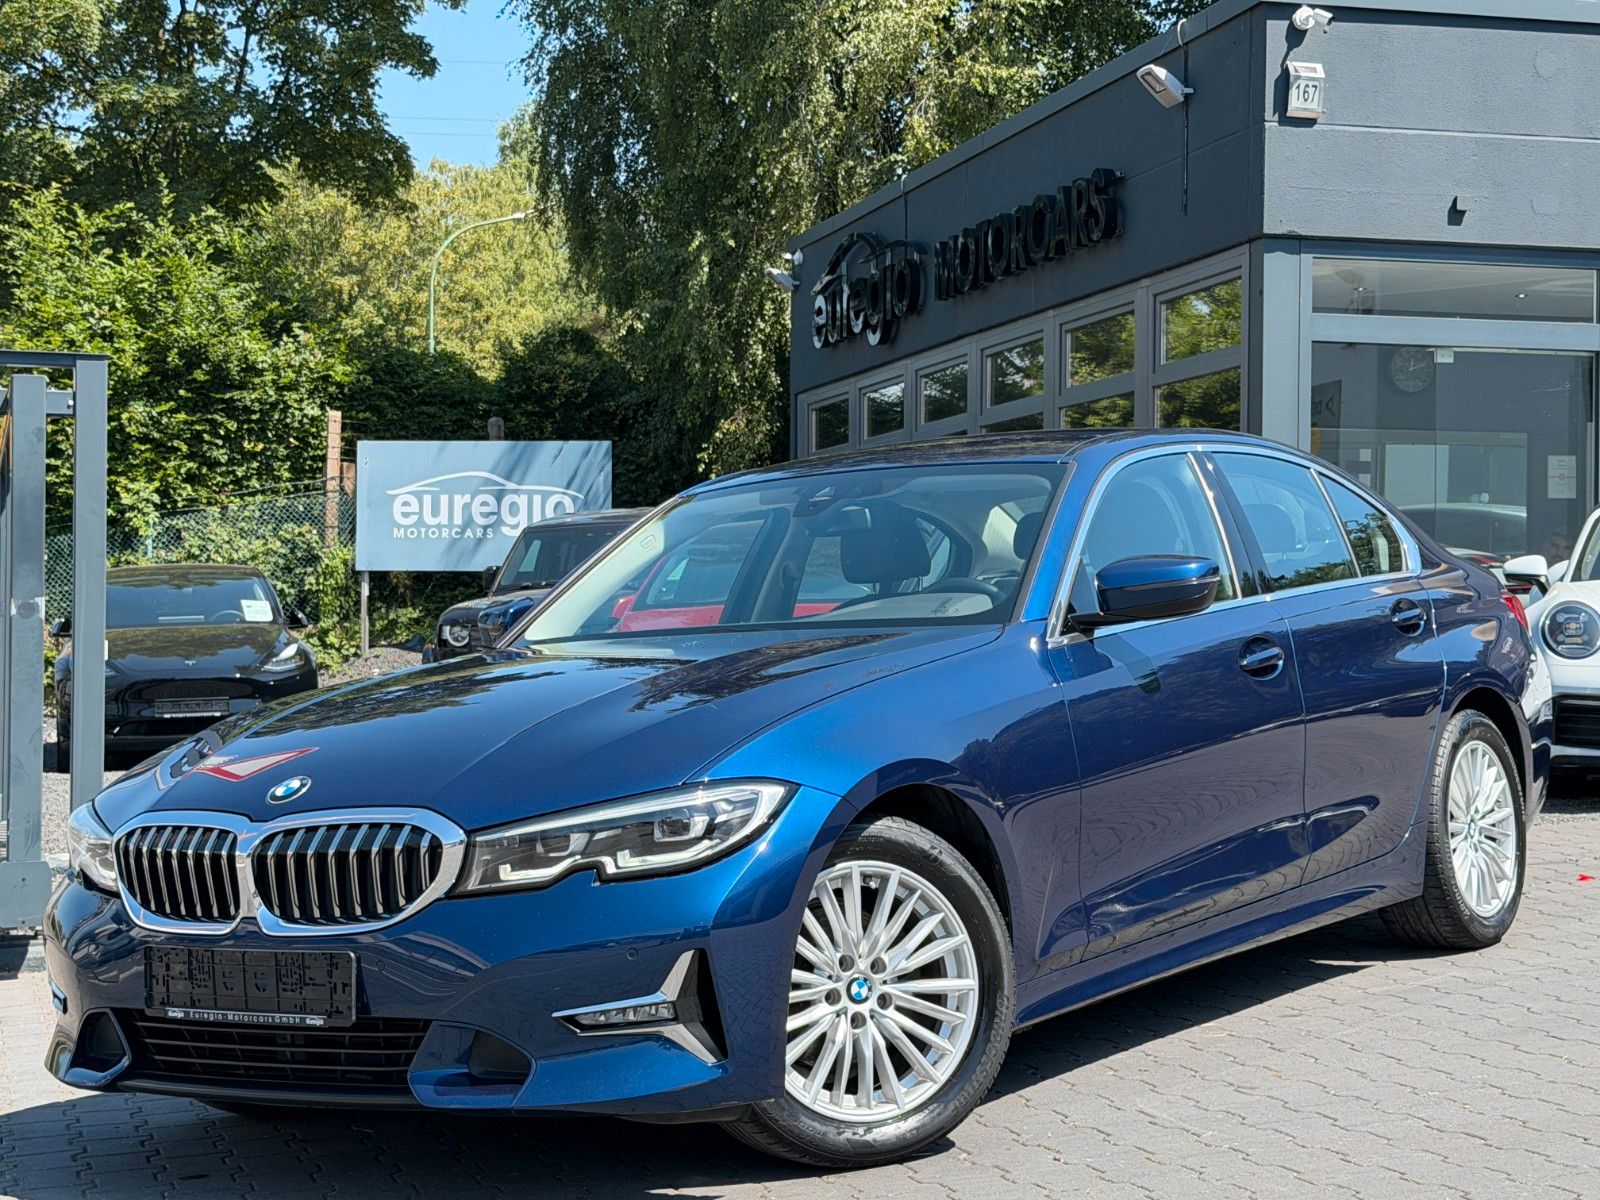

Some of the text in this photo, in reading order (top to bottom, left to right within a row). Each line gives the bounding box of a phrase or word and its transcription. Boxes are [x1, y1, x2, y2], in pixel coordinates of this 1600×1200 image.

[1295, 83, 1318, 103] 167
[934, 168, 1118, 301] MOTORCARS
[393, 493, 575, 537] euregio
[393, 527, 495, 539] MOTORCARS
[274, 1014, 301, 1025] GmbH
